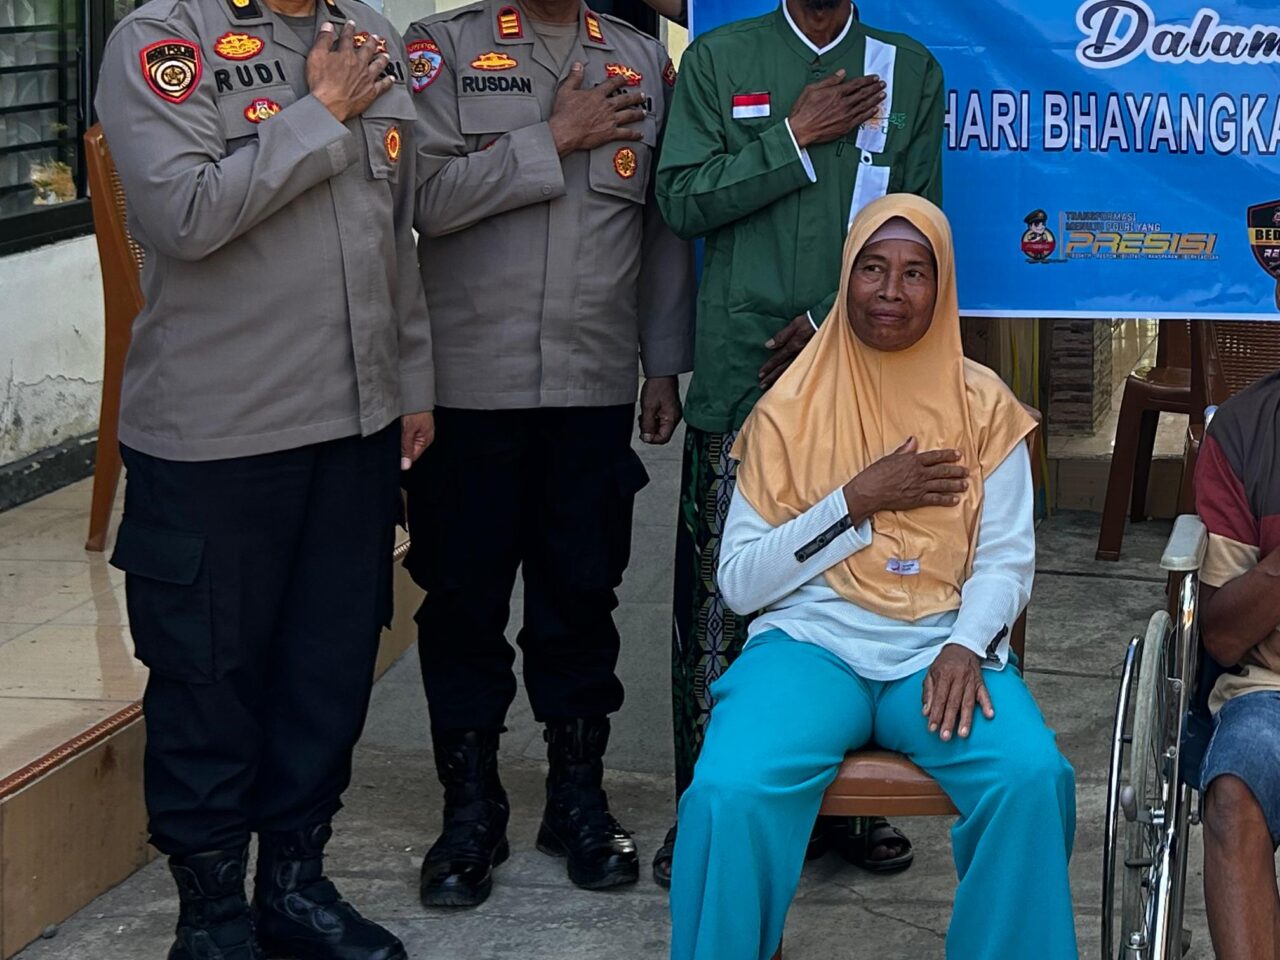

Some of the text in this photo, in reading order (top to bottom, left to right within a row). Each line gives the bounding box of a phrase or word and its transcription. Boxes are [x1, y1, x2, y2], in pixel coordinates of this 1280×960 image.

[214, 59, 286, 93] RUDI
[462, 74, 533, 94] RUSDAN
[1136, 222, 1161, 232] YANG
[1065, 231, 1217, 253] PRESISI
